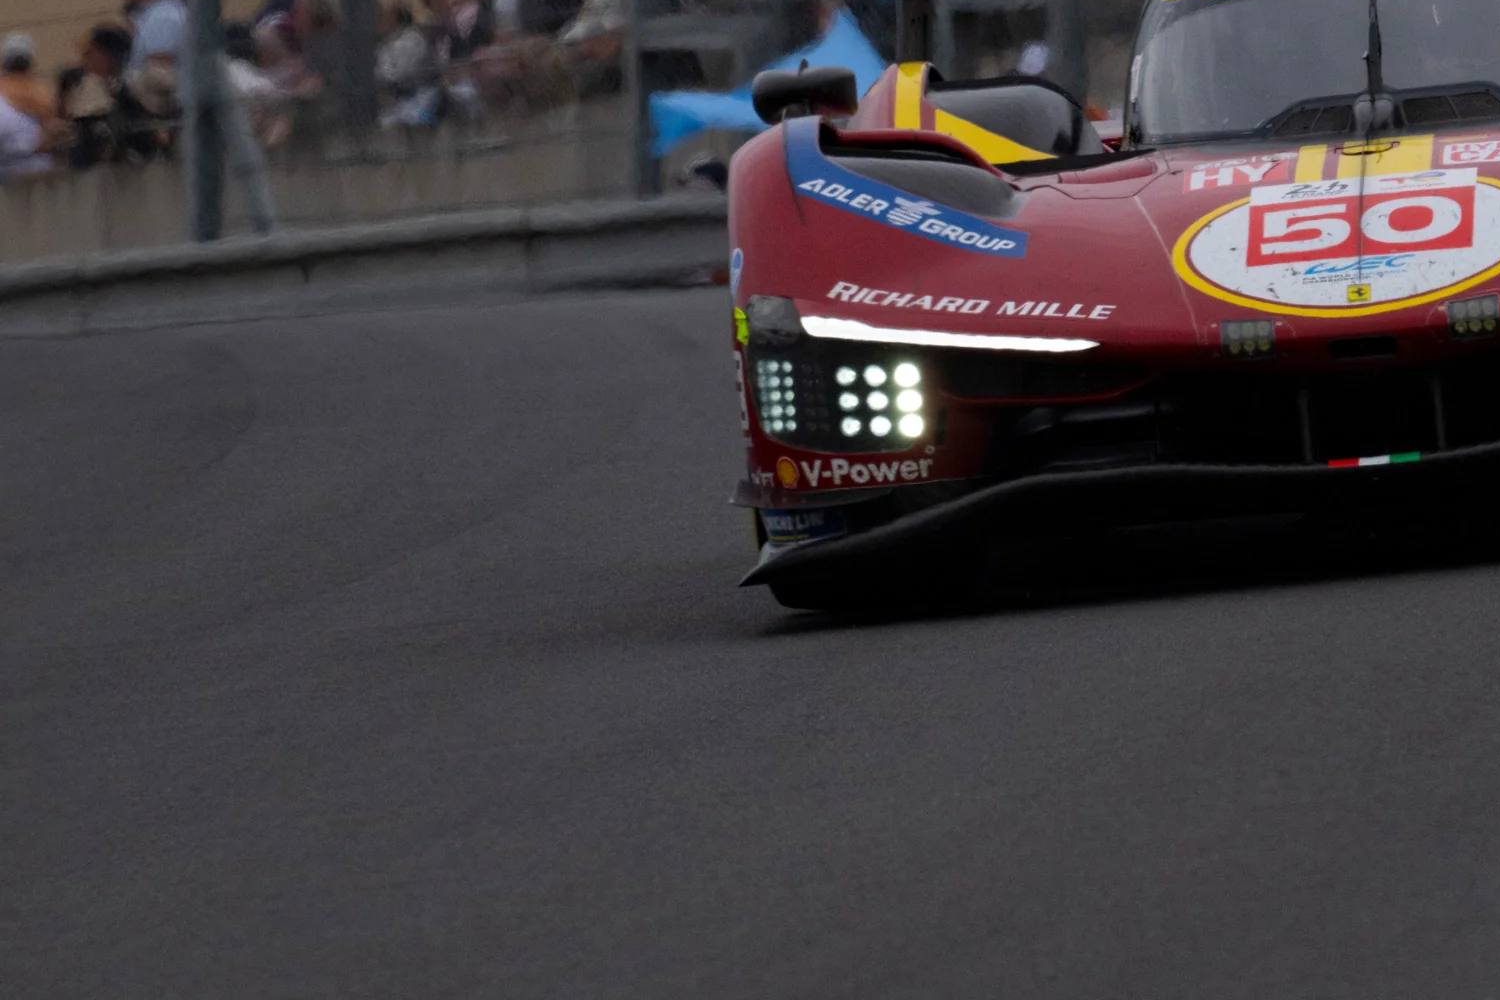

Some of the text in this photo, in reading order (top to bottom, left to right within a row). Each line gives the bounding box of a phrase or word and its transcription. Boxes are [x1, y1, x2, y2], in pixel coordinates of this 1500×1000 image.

[798, 178, 1016, 252] ADLER GROUP
[1260, 195, 1463, 256] 50
[1304, 253, 1416, 275] WEC
[826, 281, 1117, 320] RICHARD MILLE
[800, 457, 934, 487] V-Power
